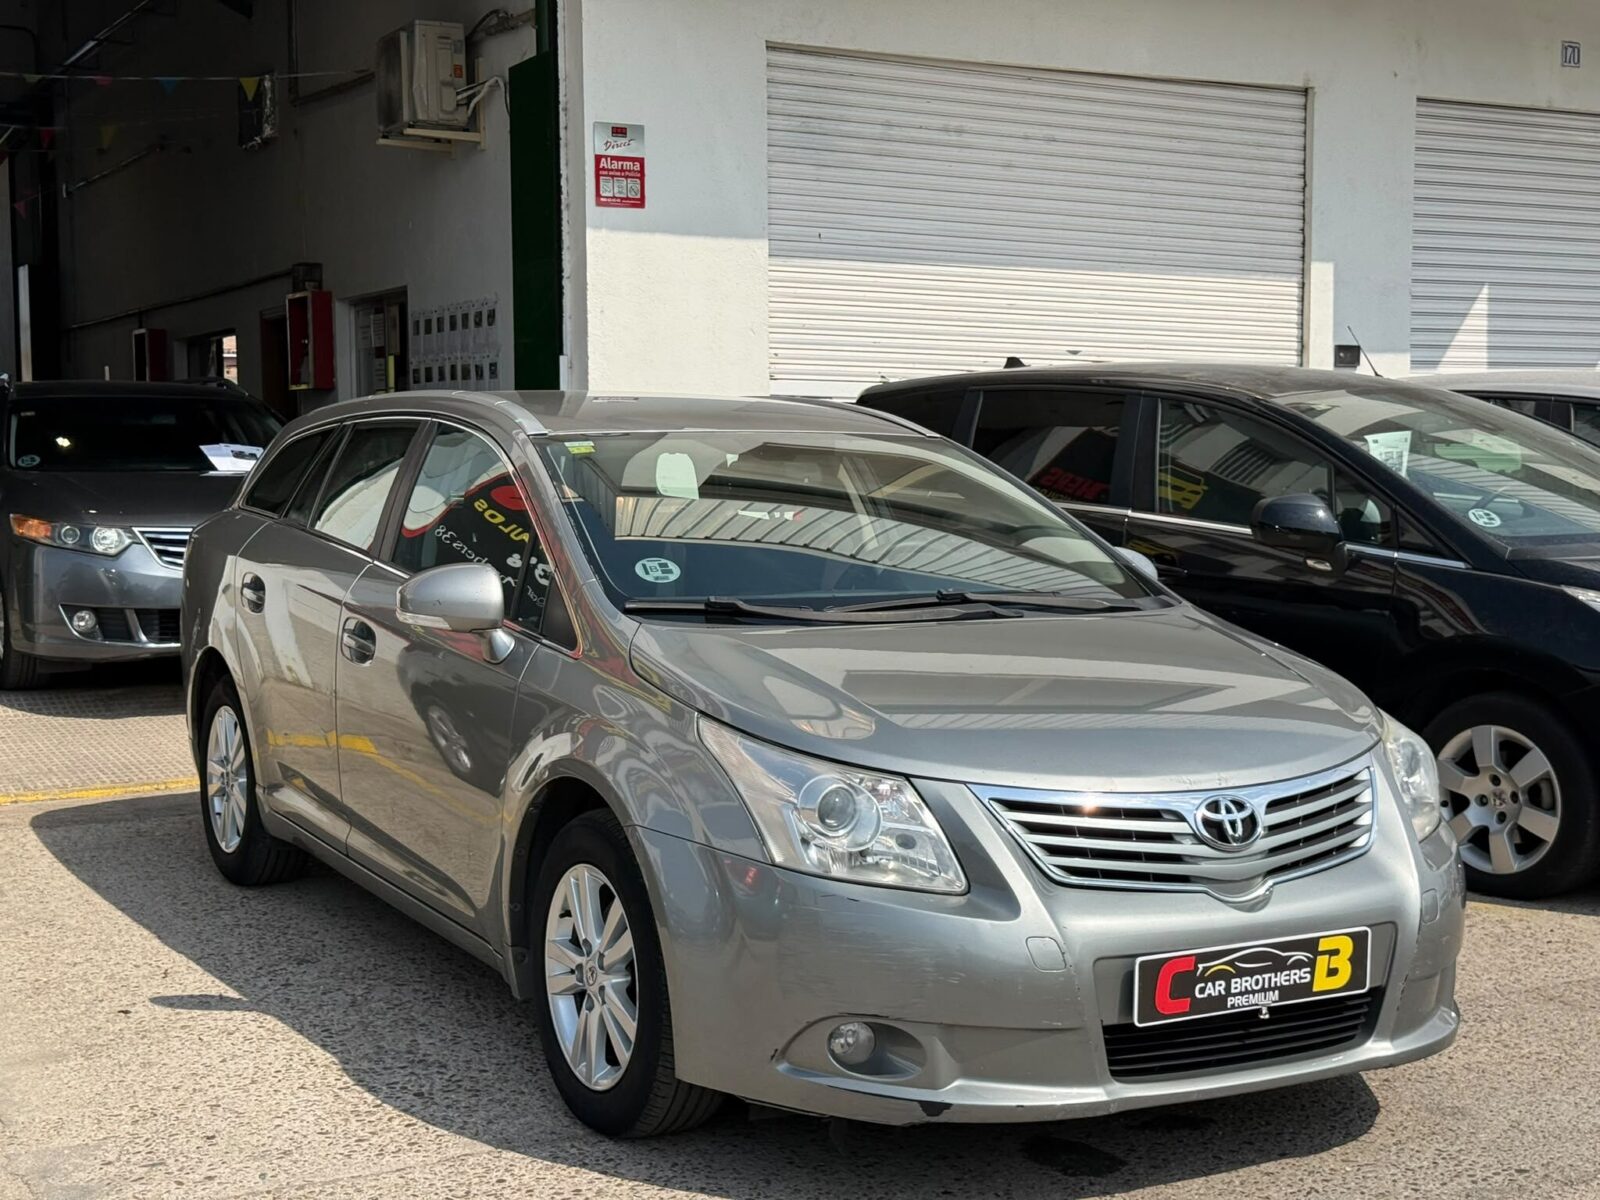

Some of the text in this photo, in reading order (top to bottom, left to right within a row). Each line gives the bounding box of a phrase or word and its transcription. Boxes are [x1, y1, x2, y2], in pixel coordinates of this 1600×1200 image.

[1564, 44, 1580, 65] 170
[599, 157, 641, 171] Alarma
[1312, 935, 1354, 992] B
[1155, 956, 1196, 1015] C
[1195, 967, 1312, 998] CAR BROTHERS
[1227, 990, 1280, 1009] PREMIUM
